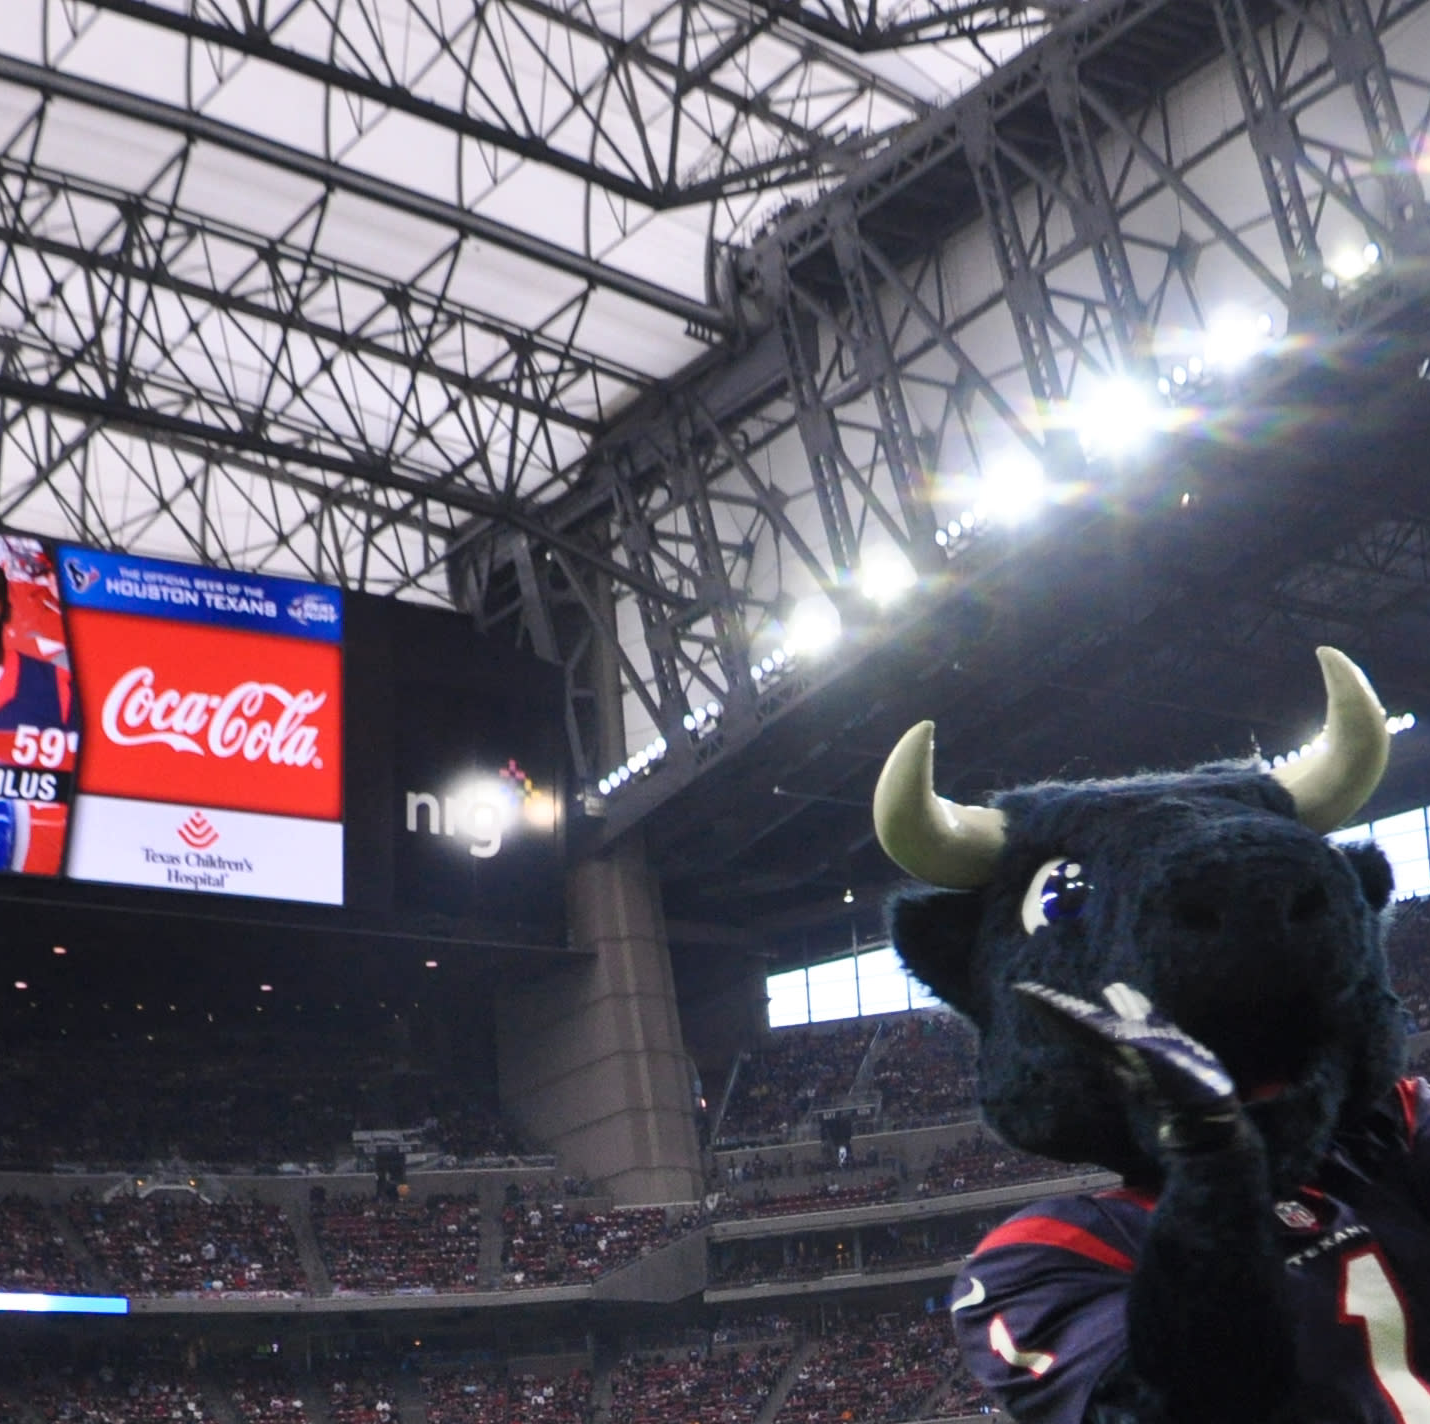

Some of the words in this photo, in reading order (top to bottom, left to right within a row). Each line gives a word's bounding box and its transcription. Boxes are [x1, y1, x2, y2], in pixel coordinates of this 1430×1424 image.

[105, 579, 199, 608] HOUSTON
[203, 592, 278, 619] TEXANS
[101, 666, 327, 768] Coca-Cola
[11, 723, 67, 768] 59
[141, 847, 182, 866] Texas
[185, 851, 253, 873] Children's
[167, 868, 226, 891] Hospital
